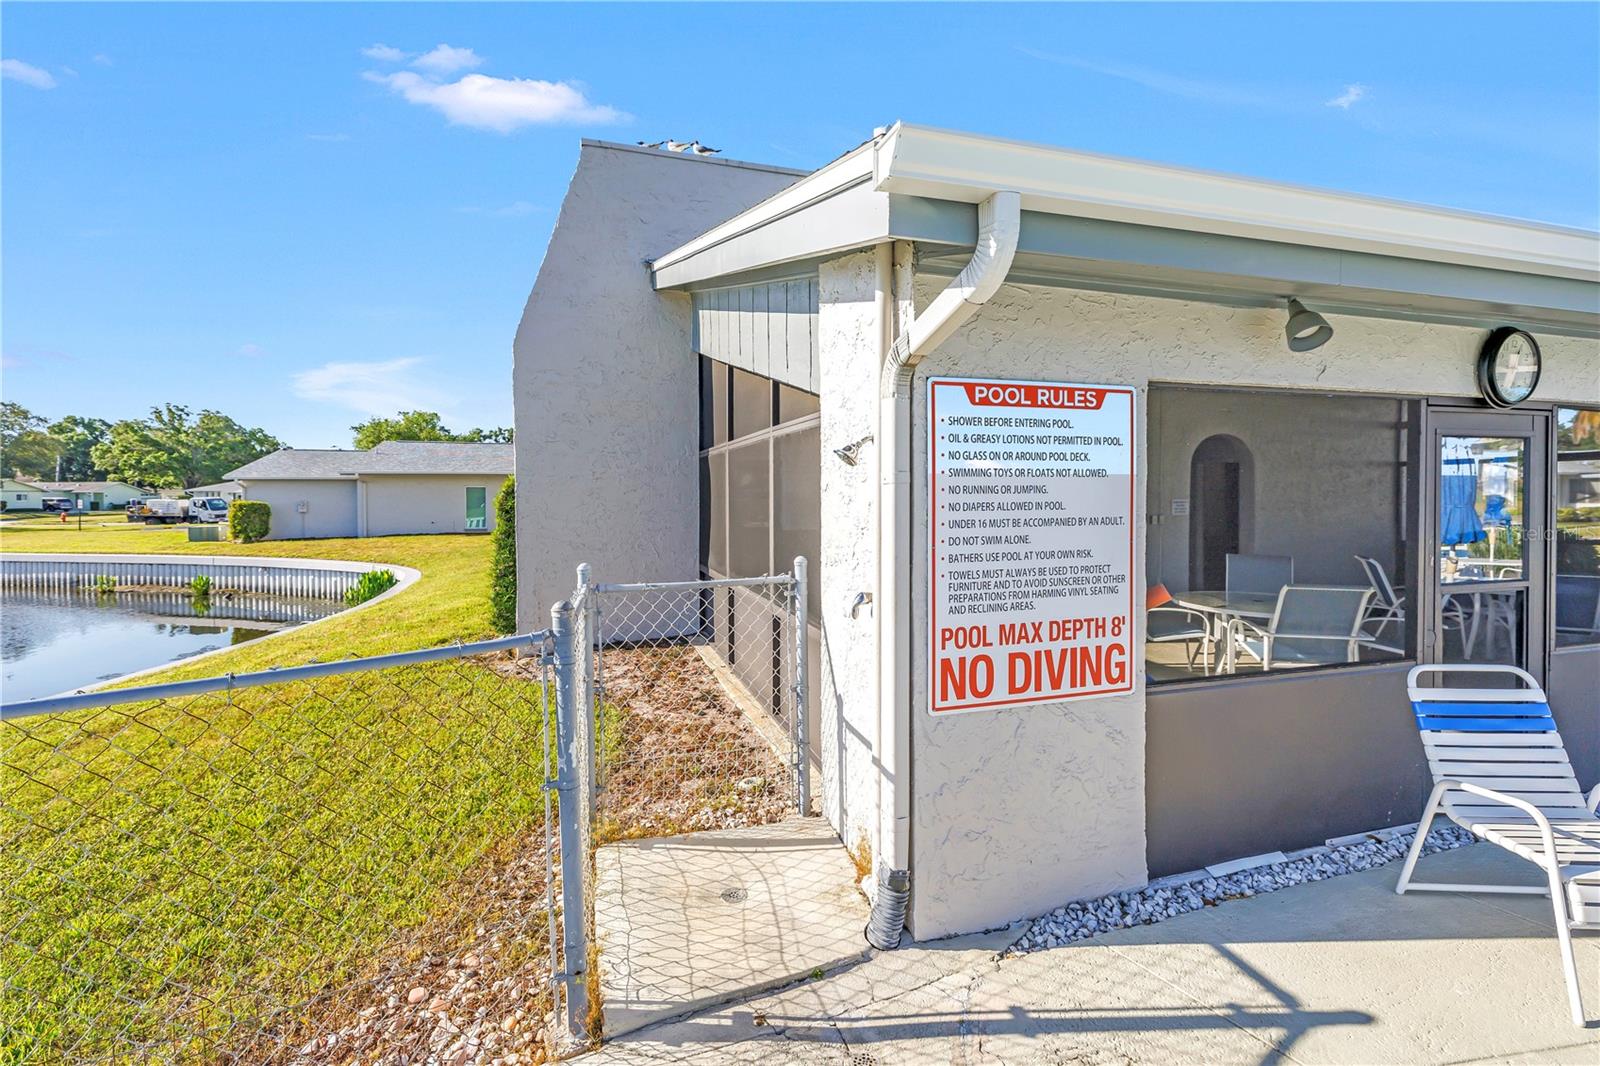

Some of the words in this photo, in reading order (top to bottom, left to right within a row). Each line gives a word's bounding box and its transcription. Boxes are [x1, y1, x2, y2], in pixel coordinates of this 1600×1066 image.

[975, 386, 1032, 405] POOL
[1037, 390, 1097, 407] RULES
[948, 416, 983, 427] SHOWER
[984, 417, 1013, 427] BEFORE
[1014, 418, 1051, 428] ENTERING
[1052, 419, 1074, 429] POOL.
[948, 434, 962, 443] OIL
[963, 434, 969, 444] &
[970, 434, 1001, 444] GREASY
[1002, 434, 1035, 445] LOTIONS
[1036, 435, 1052, 445] NOT
[1053, 436, 1093, 446] PERMITTED
[1094, 437, 1102, 446] IN
[1103, 437, 1123, 446] POOL.
[948, 451, 961, 461] NO
[962, 451, 988, 461] GLASS
[988, 452, 1001, 461] ON
[1002, 452, 1014, 461] OR
[1014, 452, 1048, 462] AROUND
[1048, 452, 1069, 462] POOL
[1070, 452, 1090, 462] DECK.
[948, 468, 992, 478] SWIMMING
[993, 468, 1013, 478] TOYS
[1014, 468, 1026, 478] OR
[1027, 468, 1055, 478] FLOATS
[1056, 468, 1072, 478] NOT
[1072, 468, 1109, 478] ALLOWED.
[948, 485, 961, 495] NO
[962, 485, 1000, 495] RUNNING
[1000, 485, 1012, 495] OR
[1012, 485, 1049, 495] JUMPING.
[948, 502, 961, 512] NO
[962, 502, 995, 512] DIAPERS
[996, 502, 1034, 512] ALLOWED
[1035, 501, 1042, 511] IN
[1044, 501, 1066, 511] POOL.
[948, 519, 977, 530] UNDER
[978, 519, 987, 529] 16
[988, 518, 1011, 529] MUST
[1012, 518, 1022, 528] BE
[1022, 517, 1077, 528] ACCOMPANIED
[1078, 517, 1088, 527] BY
[1088, 517, 1099, 526] AN
[1100, 516, 1125, 526] ADULT.
[948, 536, 961, 547] DO
[962, 536, 980, 546] NOT
[981, 535, 1003, 546] SWIM
[1004, 535, 1031, 545] ALONE.
[948, 553, 984, 564] BATHERS
[985, 552, 1000, 563] USE
[1001, 552, 1022, 562] POOL
[1023, 551, 1034, 561] AT
[1034, 550, 1056, 561] YOUR
[1057, 550, 1076, 560] OWN
[1076, 549, 1094, 559] RISK.
[948, 570, 981, 580] TOWELS
[981, 569, 1004, 579] MUST
[1005, 568, 1037, 578] ALWAYS
[1038, 567, 1047, 577] BE
[1048, 566, 1068, 577] USED
[1068, 566, 1080, 575] TO
[1081, 564, 1111, 575] PROTECT
[948, 580, 992, 592] FURNITURE
[993, 579, 1011, 590] AND
[1011, 579, 1023, 589] TO
[1024, 578, 1048, 589] AVOID
[1049, 576, 1091, 588] SUNSCREEN
[1091, 575, 1102, 585] OR
[1103, 574, 1125, 585] OTHER
[948, 591, 1007, 603] PREPARATIONS
[1008, 590, 1031, 600] FROM
[1032, 588, 1067, 599] HARMING
[1067, 587, 1088, 597] VINYL
[1089, 585, 1119, 596] SEATING
[948, 604, 966, 615] AND
[968, 602, 1009, 614] RECLINING
[1009, 601, 1036, 611] AREAS.
[941, 625, 993, 650] POOL
[999, 622, 1043, 646] MAX
[1049, 617, 1106, 642] DEPTH
[1111, 616, 1126, 637] 8'
[940, 654, 995, 702] NO
[1008, 643, 1126, 696] DIVING
